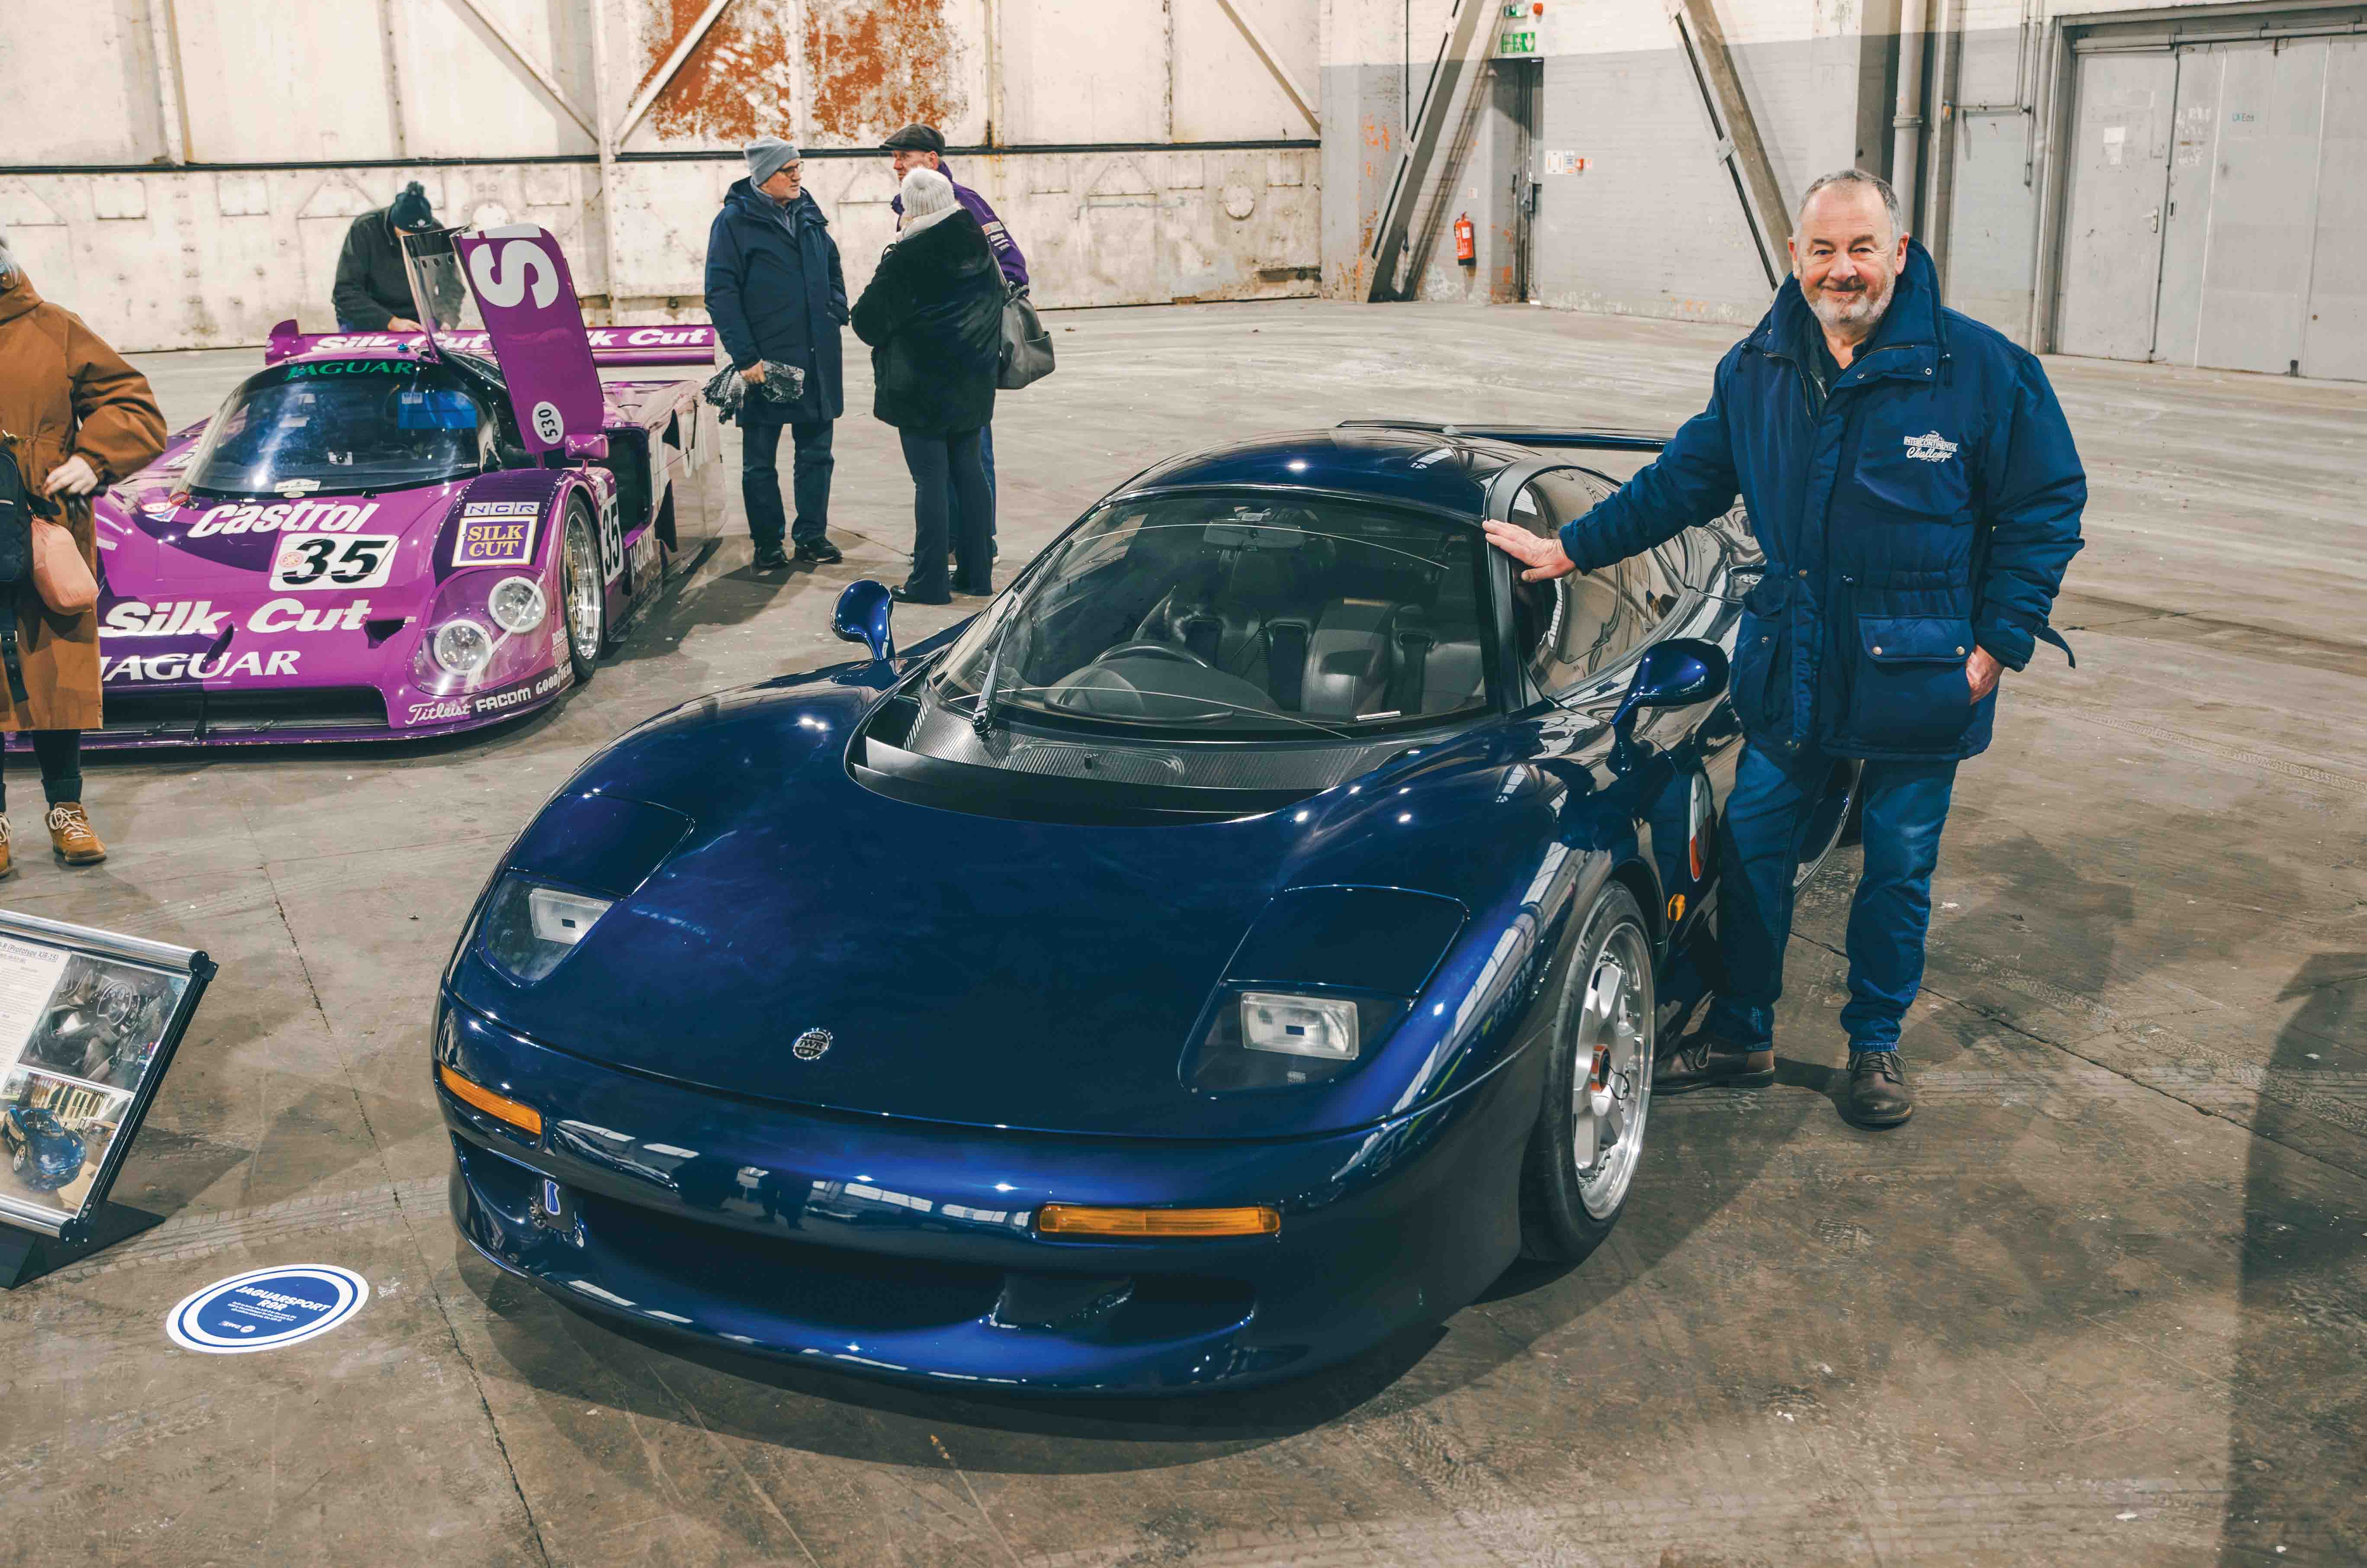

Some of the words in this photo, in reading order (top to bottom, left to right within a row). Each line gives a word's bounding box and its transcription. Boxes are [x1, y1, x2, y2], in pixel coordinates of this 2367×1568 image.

[628, 329, 708, 345] Cut
[284, 362, 414, 381] JAGUAR
[538, 408, 558, 437] 530
[1906, 447, 1953, 463] Challenge
[187, 500, 380, 538] Castrol
[467, 525, 525, 541] SILK
[602, 502, 620, 576] 35
[282, 539, 389, 585] 35
[468, 541, 519, 557] CUT
[98, 600, 232, 637] Silk
[247, 598, 373, 634] Cut
[405, 701, 472, 725] Titleist
[476, 688, 532, 712] FACOM
[235, 1286, 332, 1312] JAGUARSPORT
[257, 1299, 288, 1312] R9R
